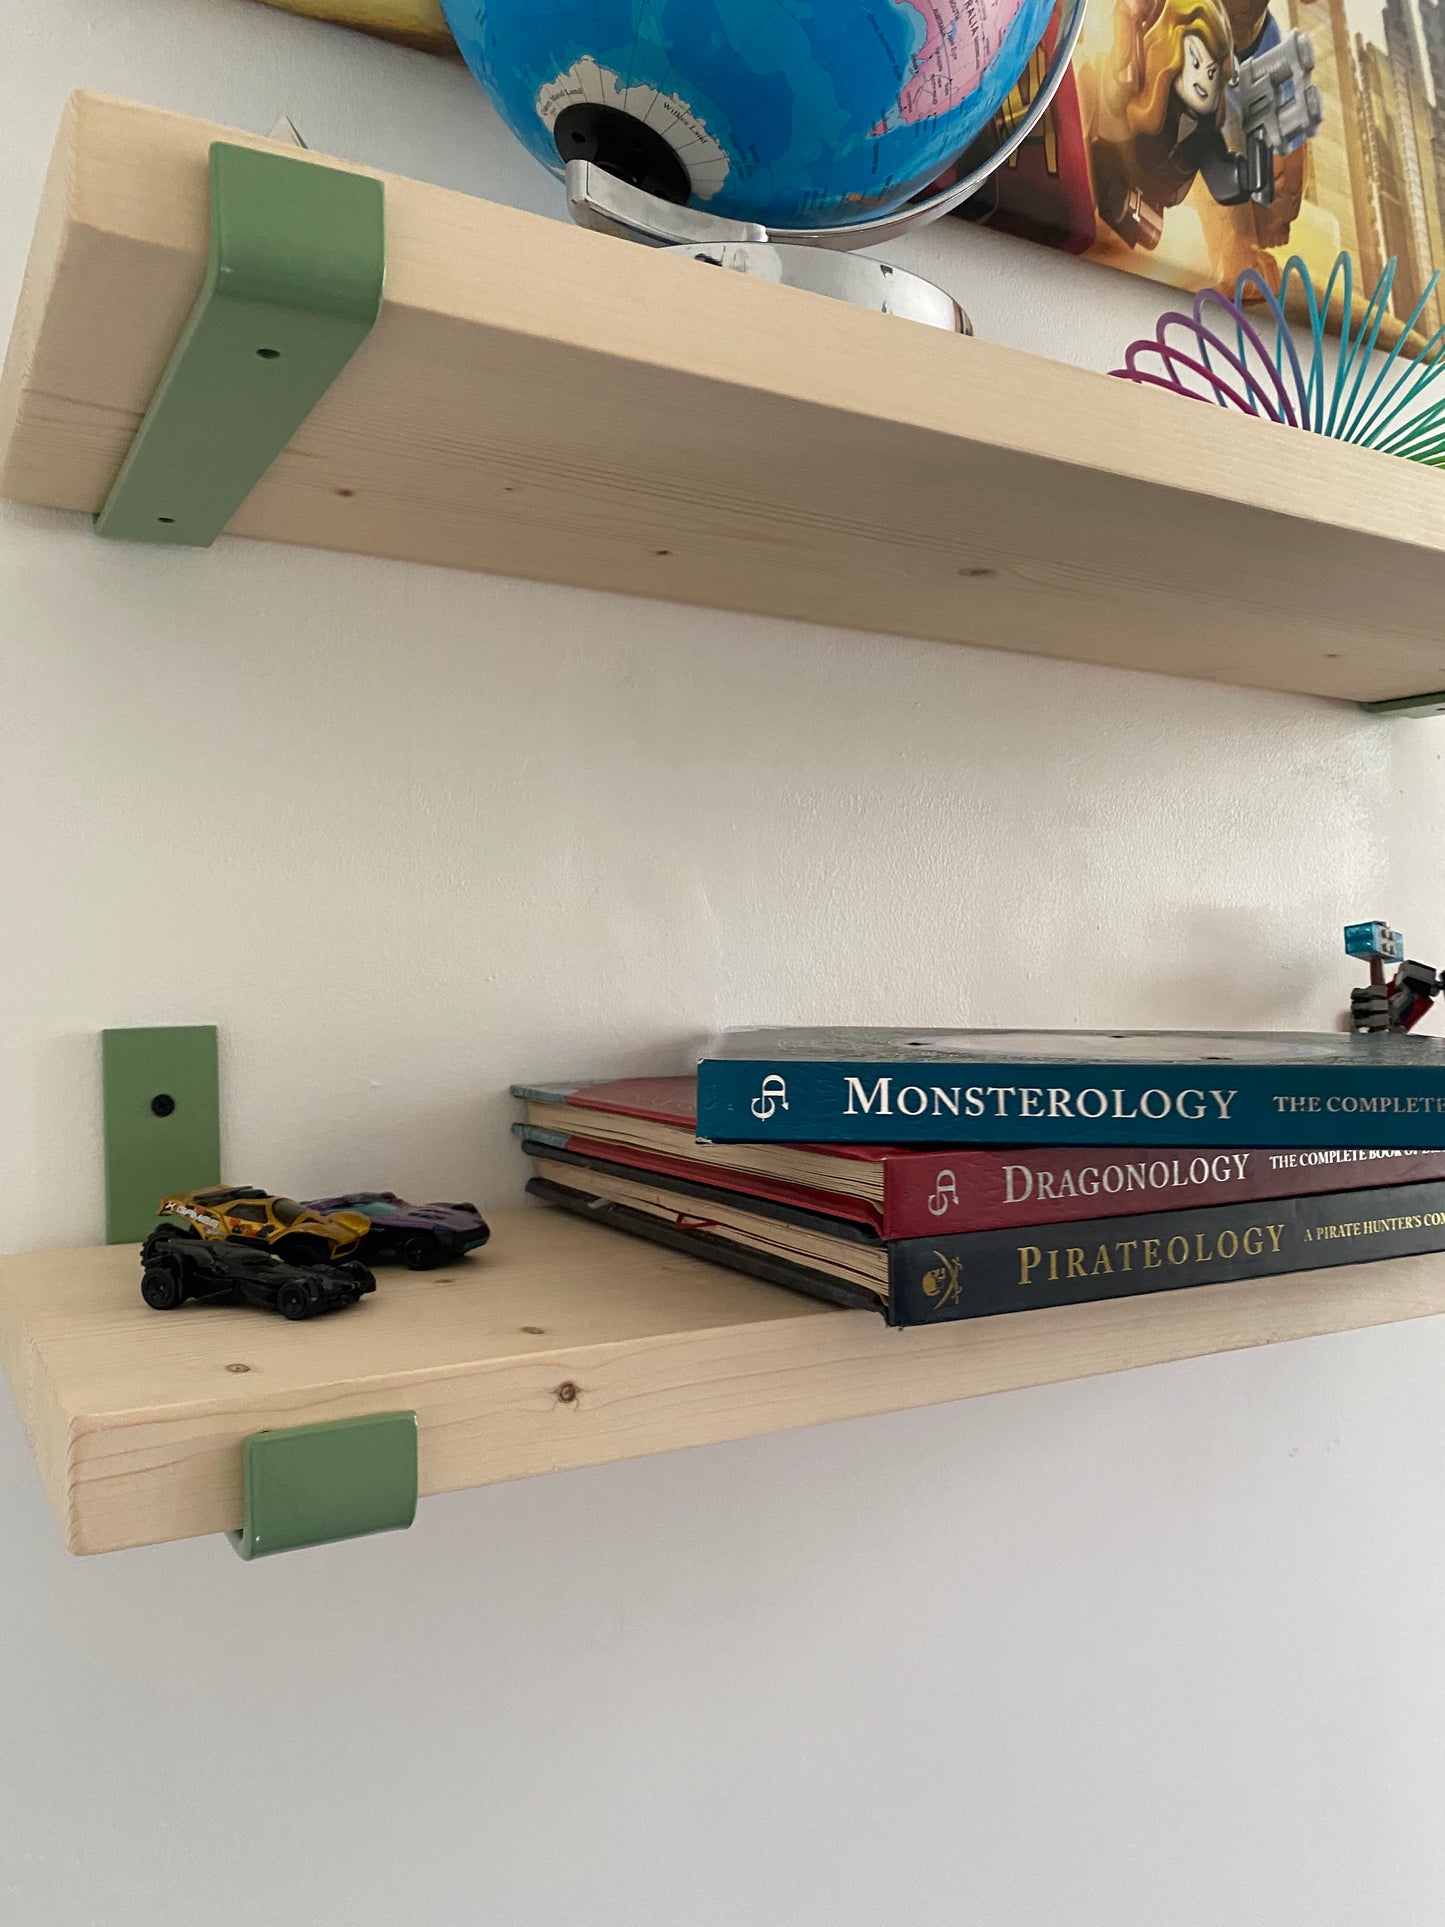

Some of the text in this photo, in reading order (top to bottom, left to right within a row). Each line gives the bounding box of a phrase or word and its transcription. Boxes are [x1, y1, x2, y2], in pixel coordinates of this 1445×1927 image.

[663, 101, 709, 145] Wilkes Land
[843, 1076, 1445, 1119] MONSTEROLOGY THE COMPLETE
[1002, 1153, 1250, 1205] DRAGONOLOGY
[1269, 1154, 1298, 1170] THE
[1299, 1149, 1367, 1167] COMPLETE
[1017, 1224, 1285, 1286] PIRATEOLOGY
[1303, 1229, 1313, 1242] A
[1316, 1222, 1362, 1241] PIRATE
[1363, 1215, 1422, 1235] HUNTER'S
